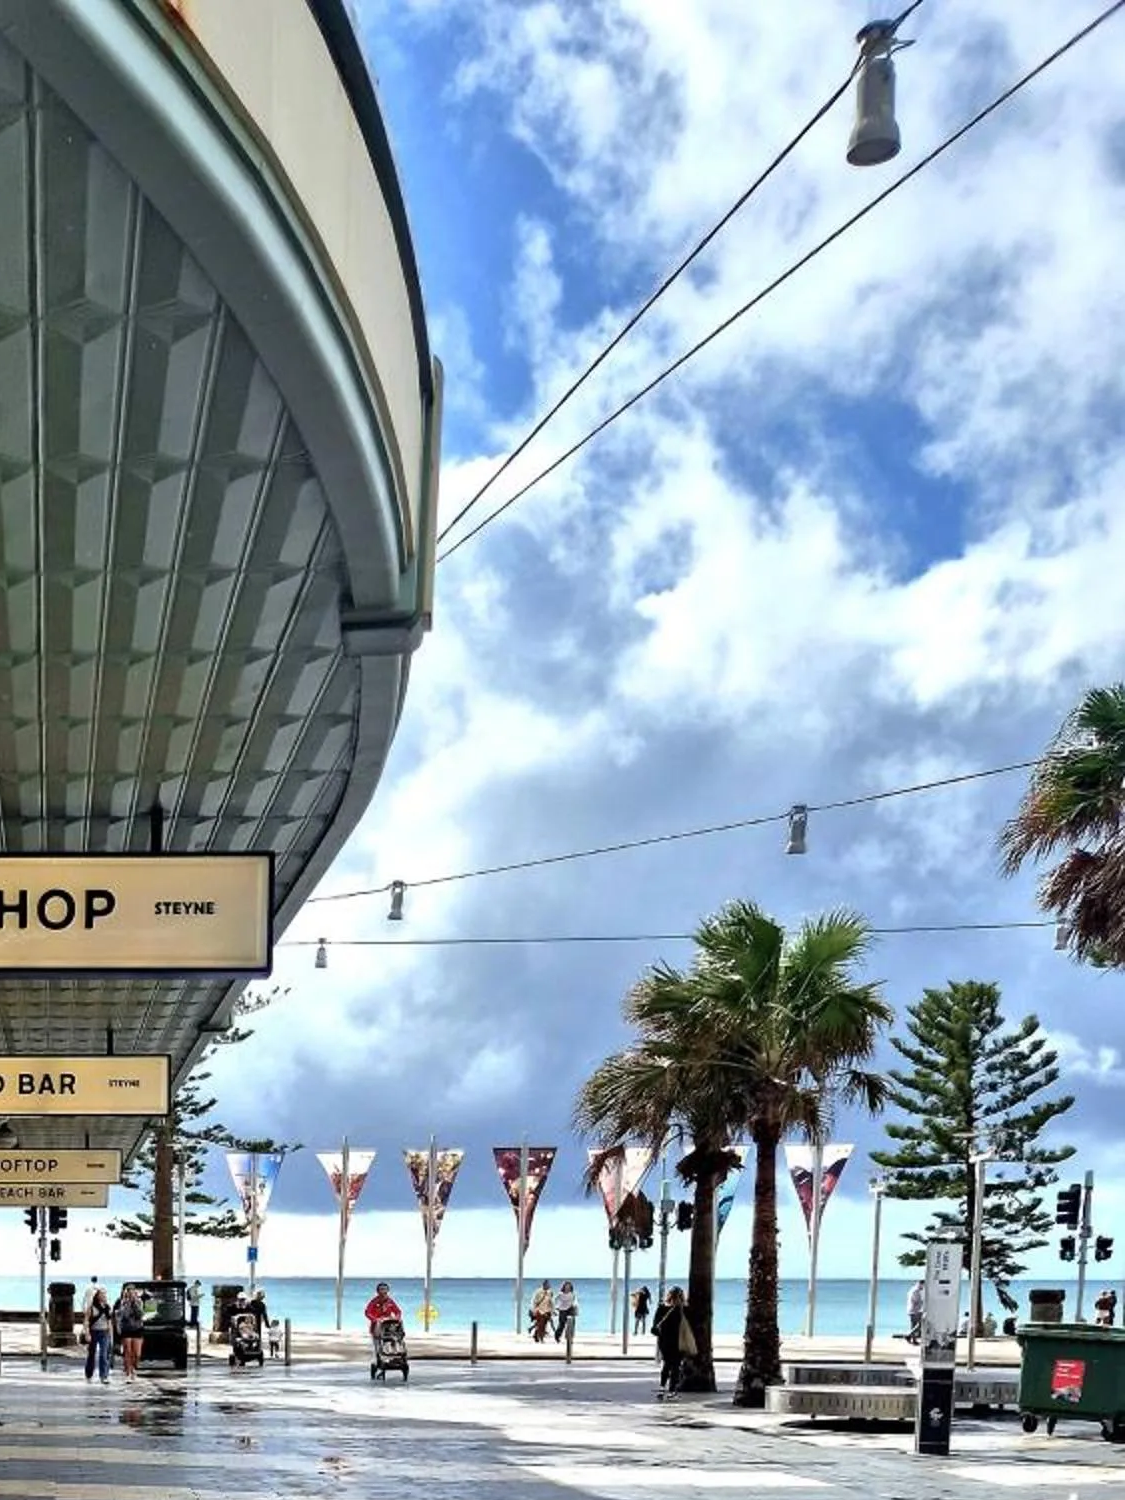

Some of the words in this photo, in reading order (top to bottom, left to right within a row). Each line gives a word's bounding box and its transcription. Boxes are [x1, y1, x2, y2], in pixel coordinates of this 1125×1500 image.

[154, 901, 216, 915] STEYNE
[18, 1073, 77, 1095] BAR
[38, 1187, 66, 1199] BAR
